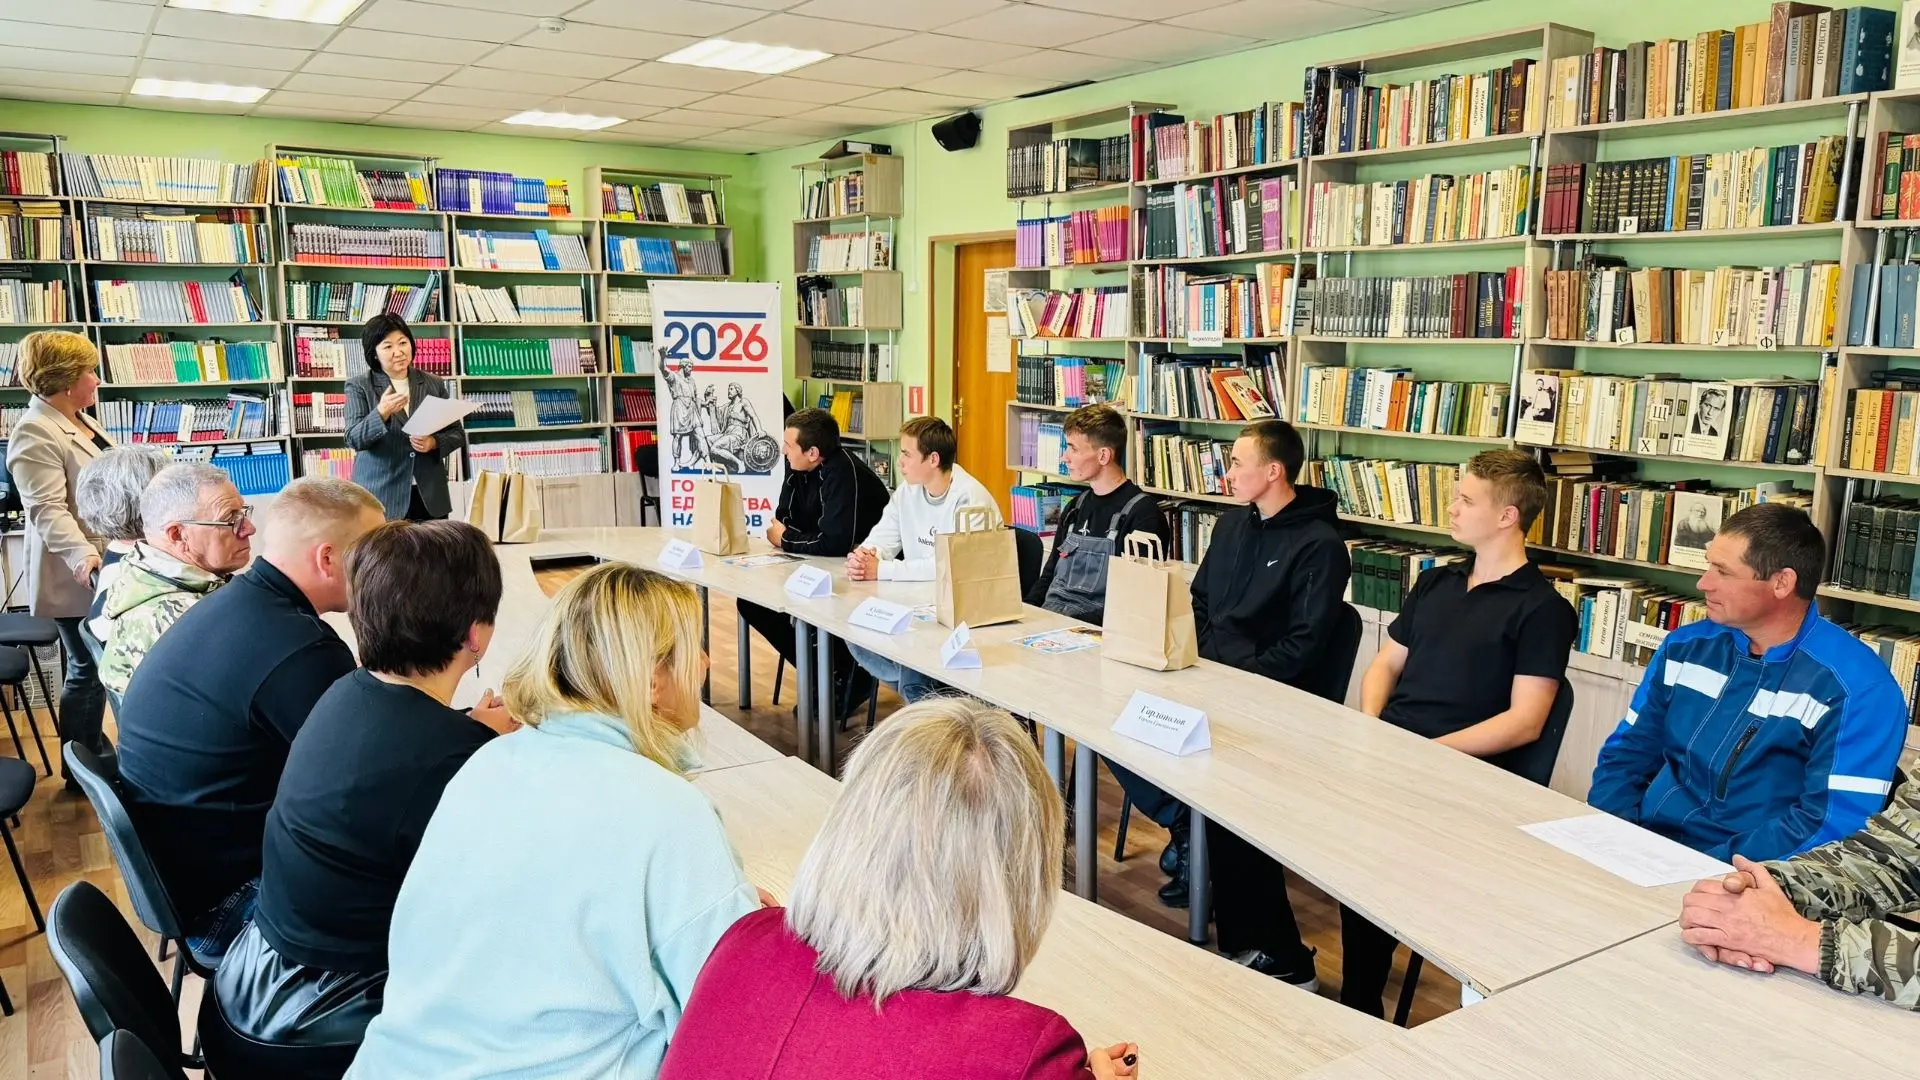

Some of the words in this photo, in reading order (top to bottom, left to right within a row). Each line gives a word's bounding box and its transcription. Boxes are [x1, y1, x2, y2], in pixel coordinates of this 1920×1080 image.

[1790, 19, 1800, 66] ОТРОЧЕСТВО
[1816, 18, 1827, 66] ОТРОЧЕСТВО
[1622, 219, 1633, 232] Р
[664, 321, 768, 361] 2026
[1618, 329, 1628, 343] С
[1760, 336, 1772, 349] Ф
[671, 479, 695, 493] ГО
